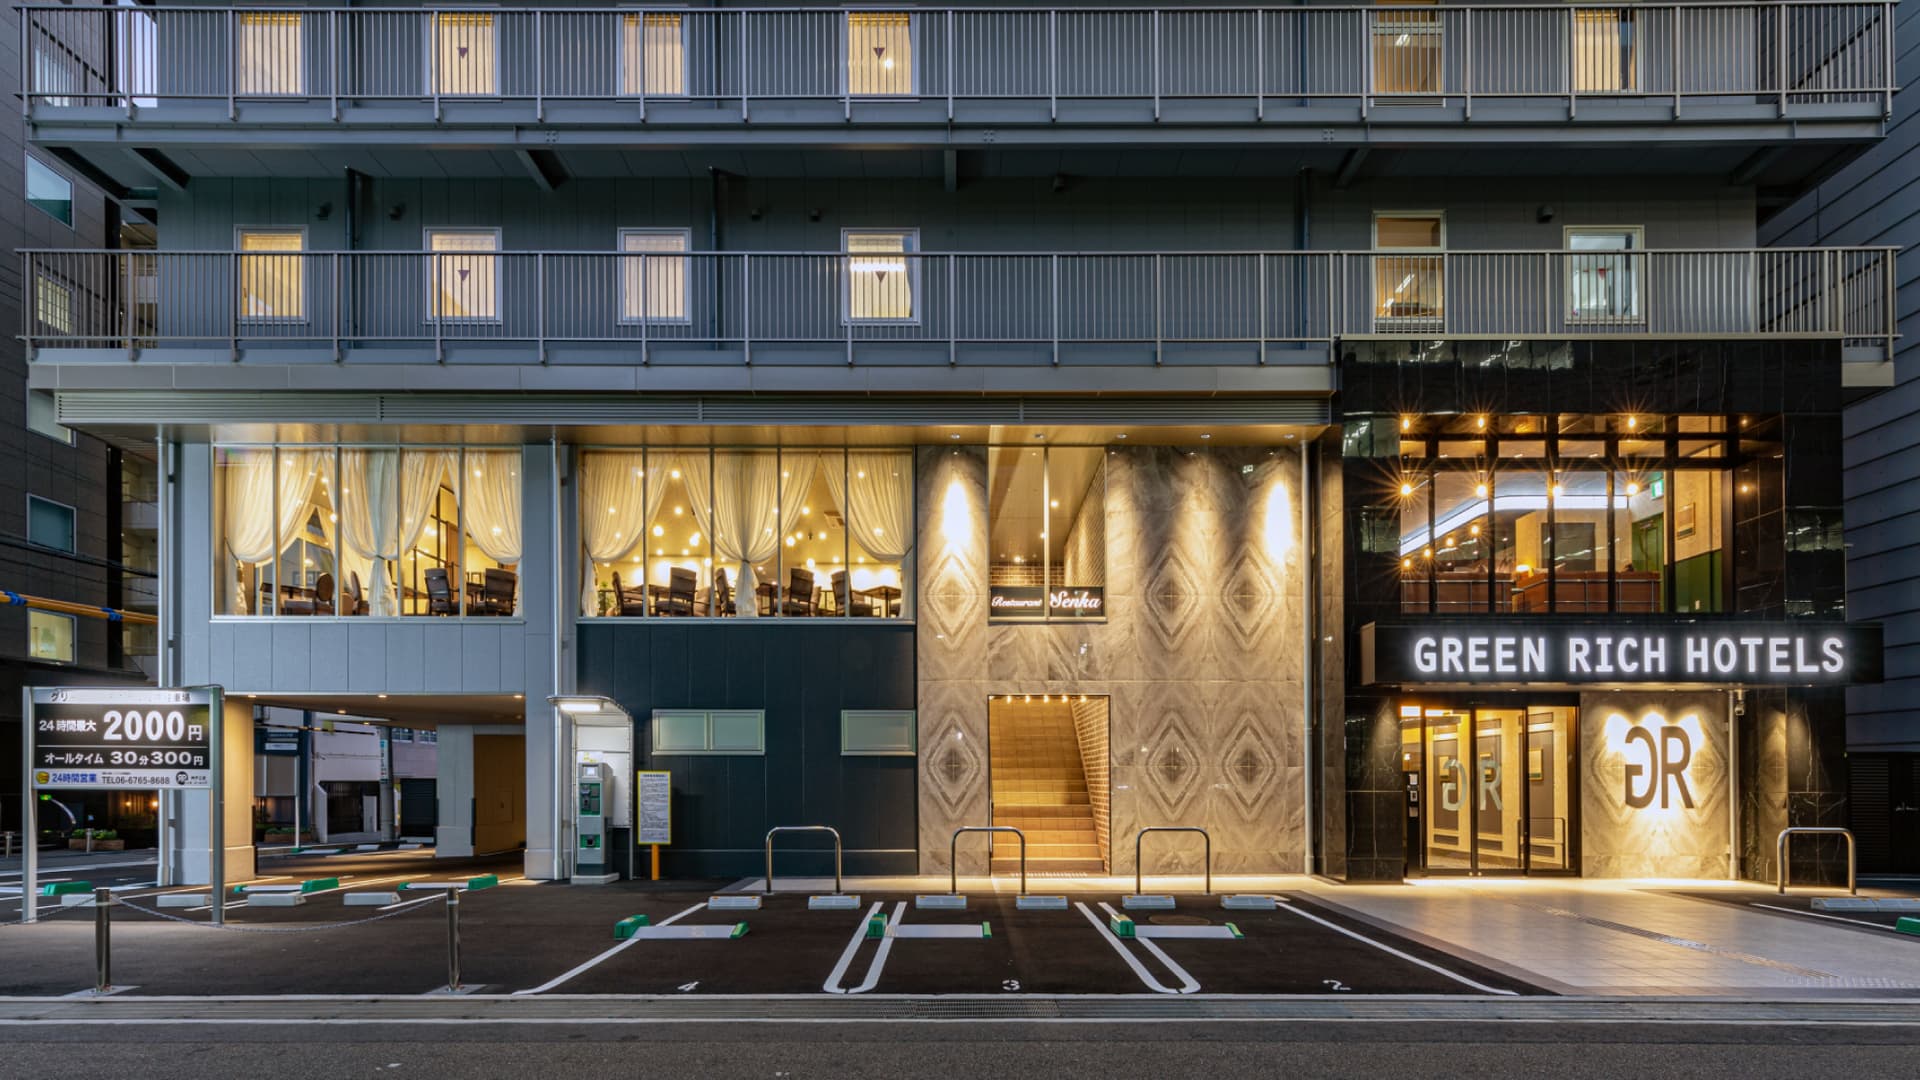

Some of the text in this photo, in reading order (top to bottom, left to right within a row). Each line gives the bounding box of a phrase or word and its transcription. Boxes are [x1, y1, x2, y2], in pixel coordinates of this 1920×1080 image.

[1050, 590, 1102, 609] Senka
[1414, 637, 1845, 673] GREEN RICH HOTELS
[39, 719, 97, 732] 24時間最大
[44, 753, 104, 765] オールタイム
[52, 773, 97, 783] 24時間営業
